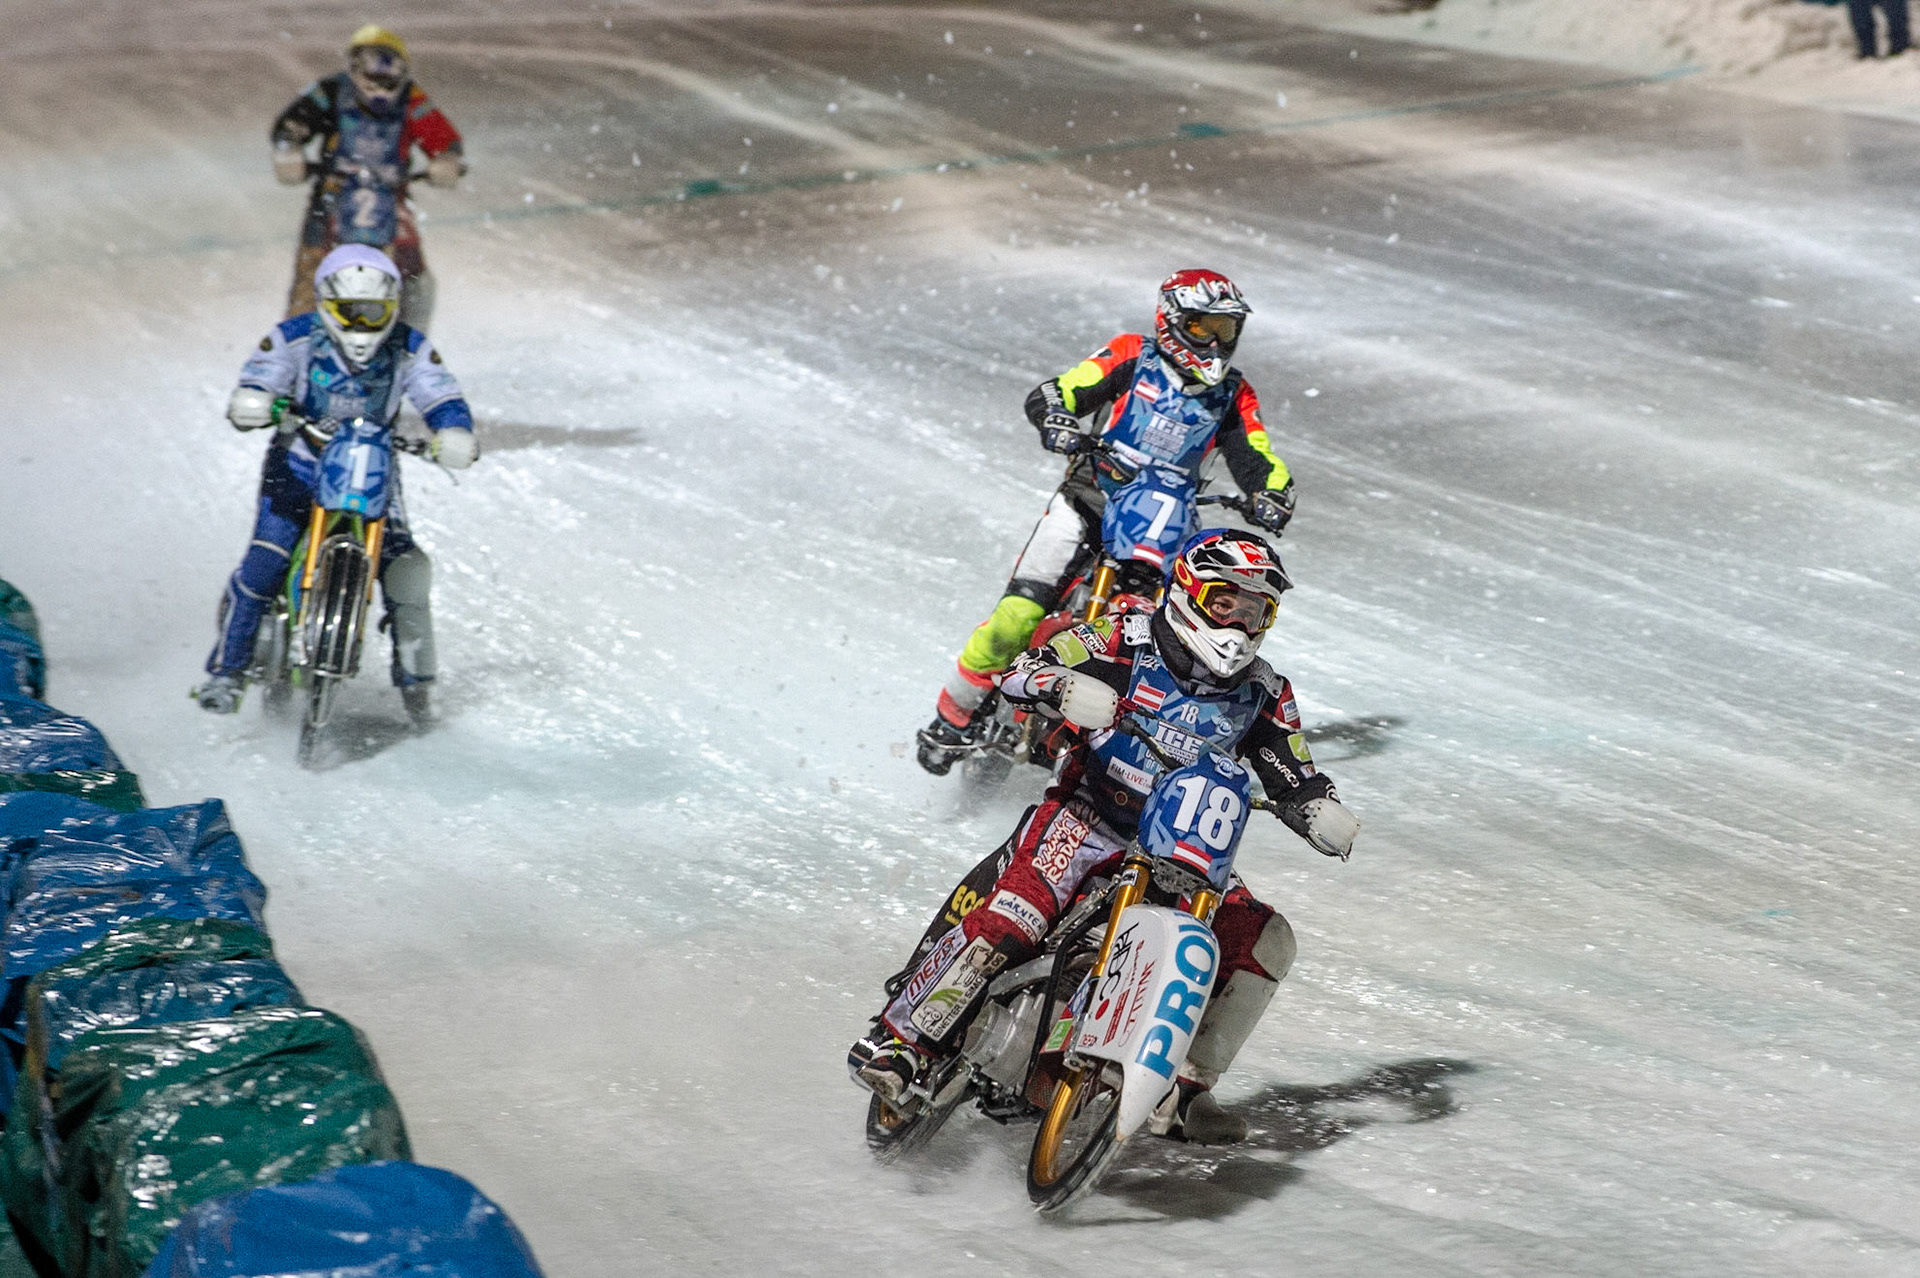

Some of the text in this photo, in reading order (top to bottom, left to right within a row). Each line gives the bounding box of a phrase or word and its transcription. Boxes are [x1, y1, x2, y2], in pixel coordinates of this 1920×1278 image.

[352, 189, 378, 228] 2
[348, 444, 371, 490] 1
[1144, 491, 1177, 541] 7
[1180, 704, 1200, 724] 18
[1154, 724, 1206, 754] ICE
[1173, 775, 1241, 851] 18
